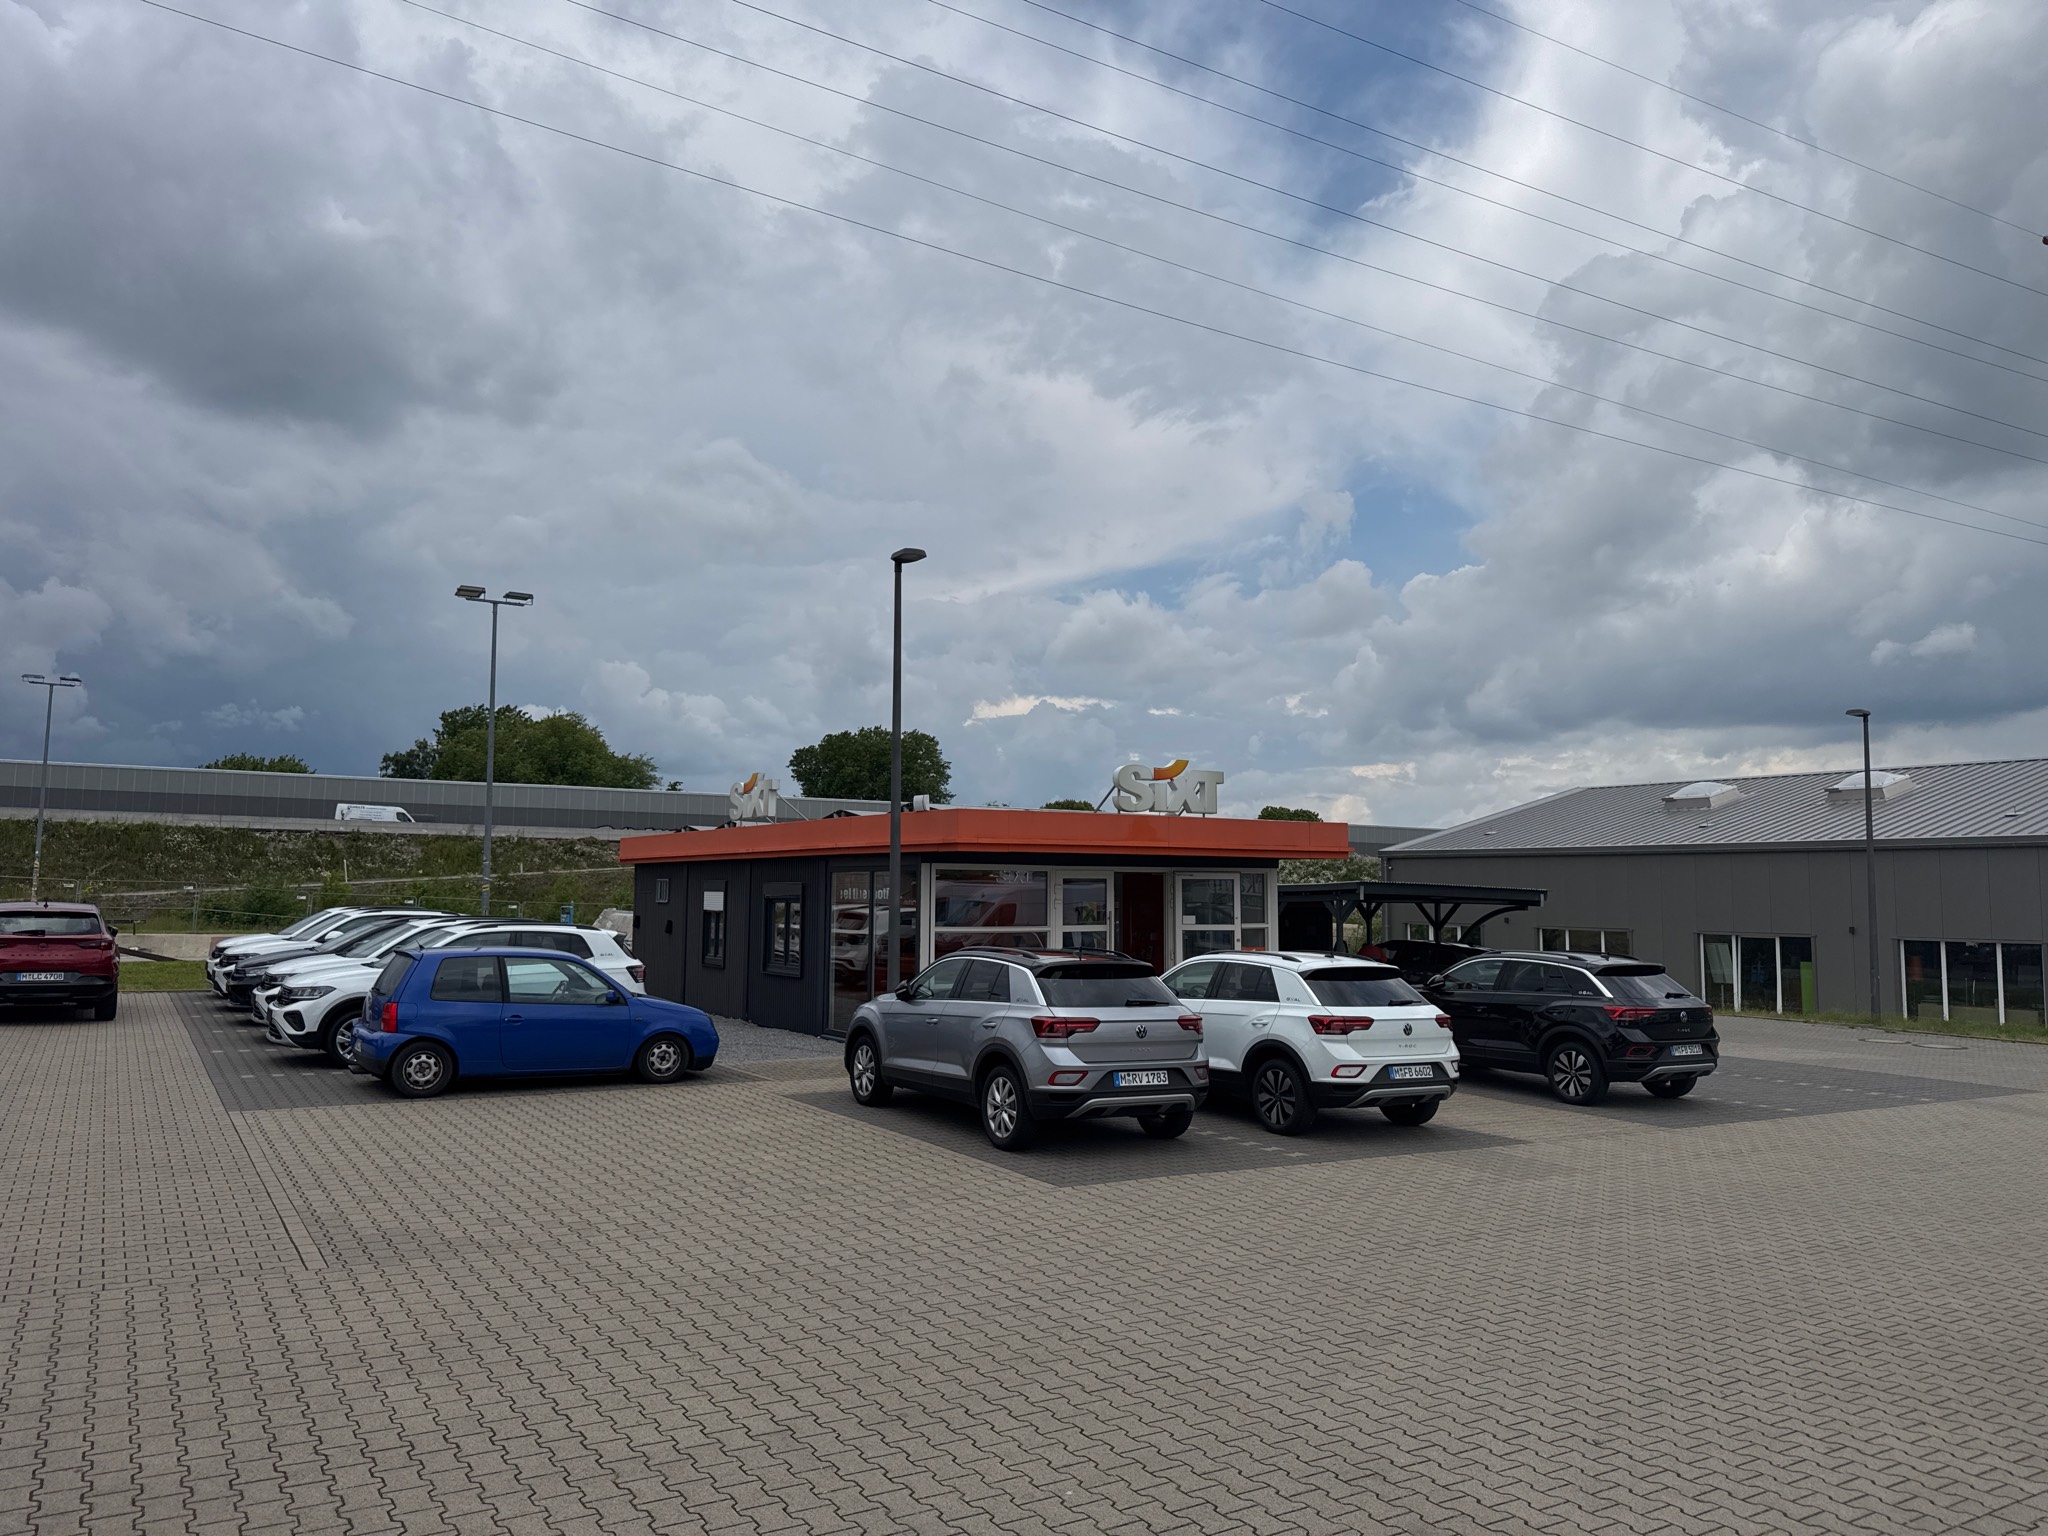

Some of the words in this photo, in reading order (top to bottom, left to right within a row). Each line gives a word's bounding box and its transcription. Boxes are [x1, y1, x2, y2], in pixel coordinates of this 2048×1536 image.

[1120, 1073, 1127, 1084] M
[1132, 1073, 1143, 1083] RV
[1145, 1071, 1167, 1083] 1783
[1394, 1067, 1400, 1077] M
[1404, 1067, 1413, 1077] FB
[1415, 1066, 1433, 1076] 6602
